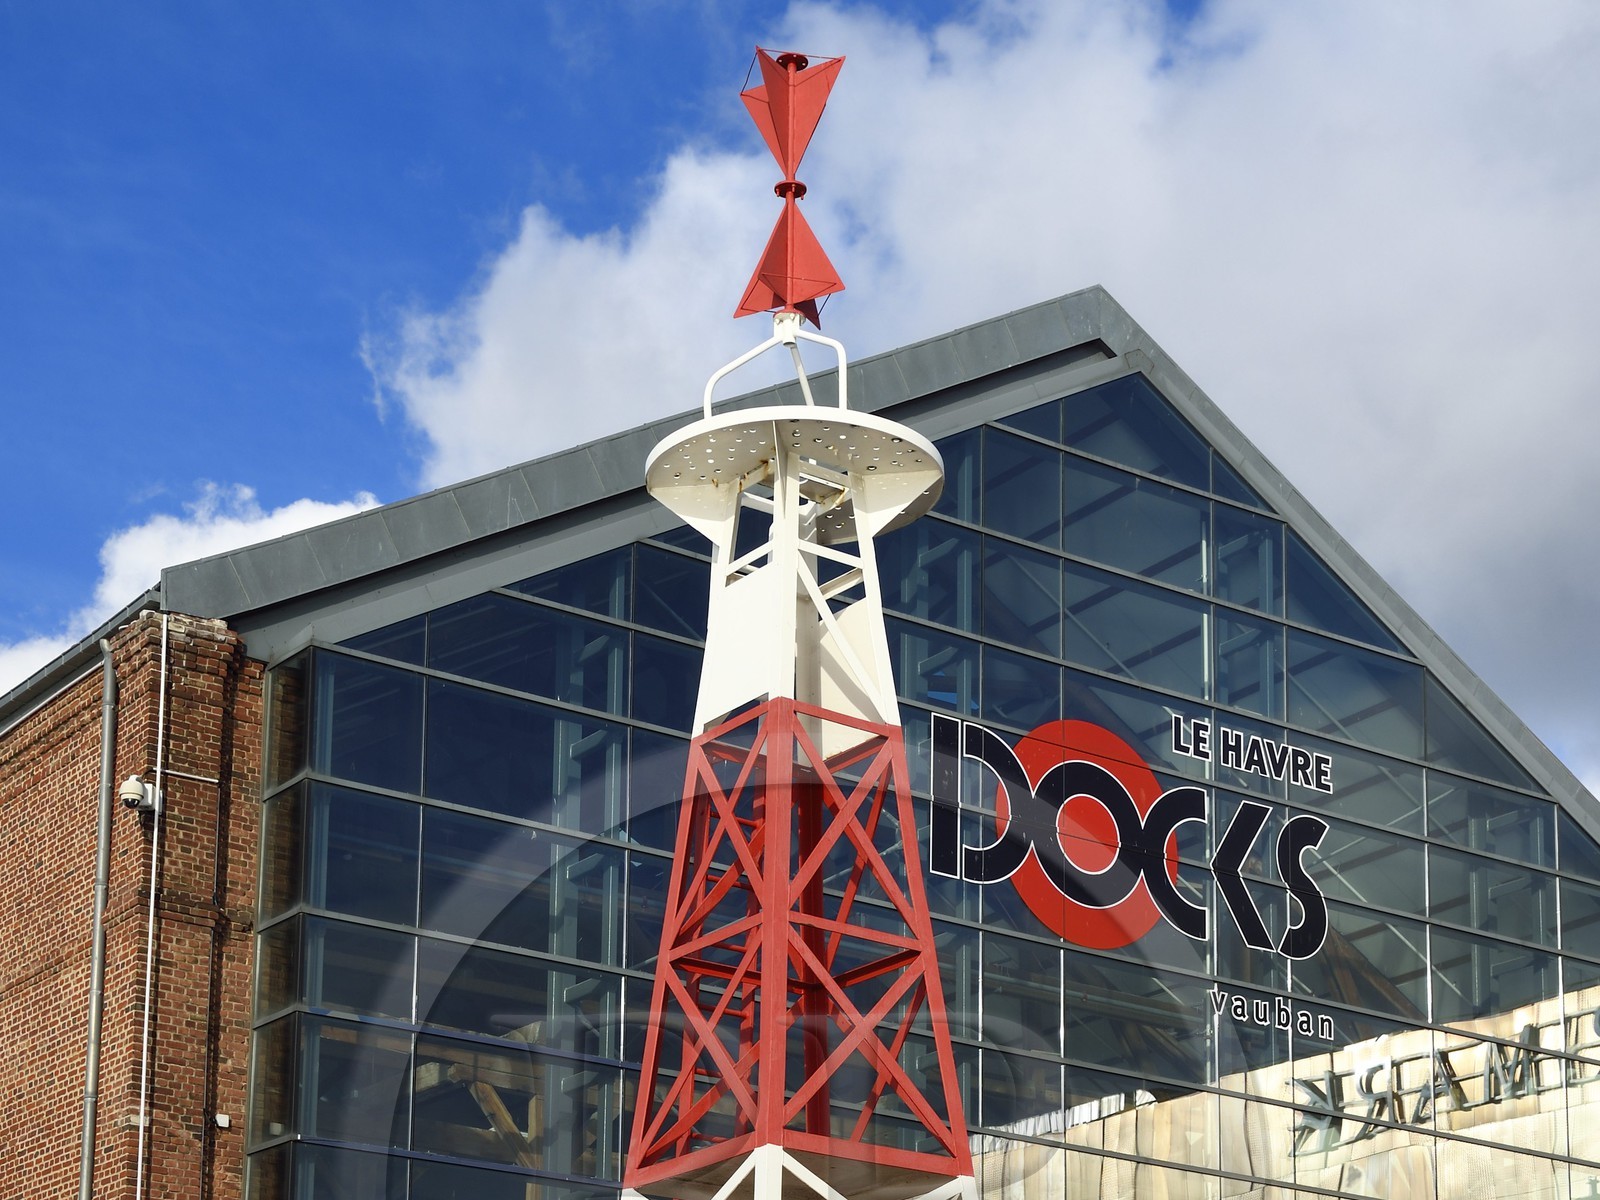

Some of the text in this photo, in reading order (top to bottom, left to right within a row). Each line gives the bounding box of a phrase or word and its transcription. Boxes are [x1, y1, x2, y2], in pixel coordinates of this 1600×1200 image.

[1172, 714, 1334, 795] LE HAVRE
[929, 711, 1330, 961] DOCKS
[1209, 987, 1335, 1042] vauban
